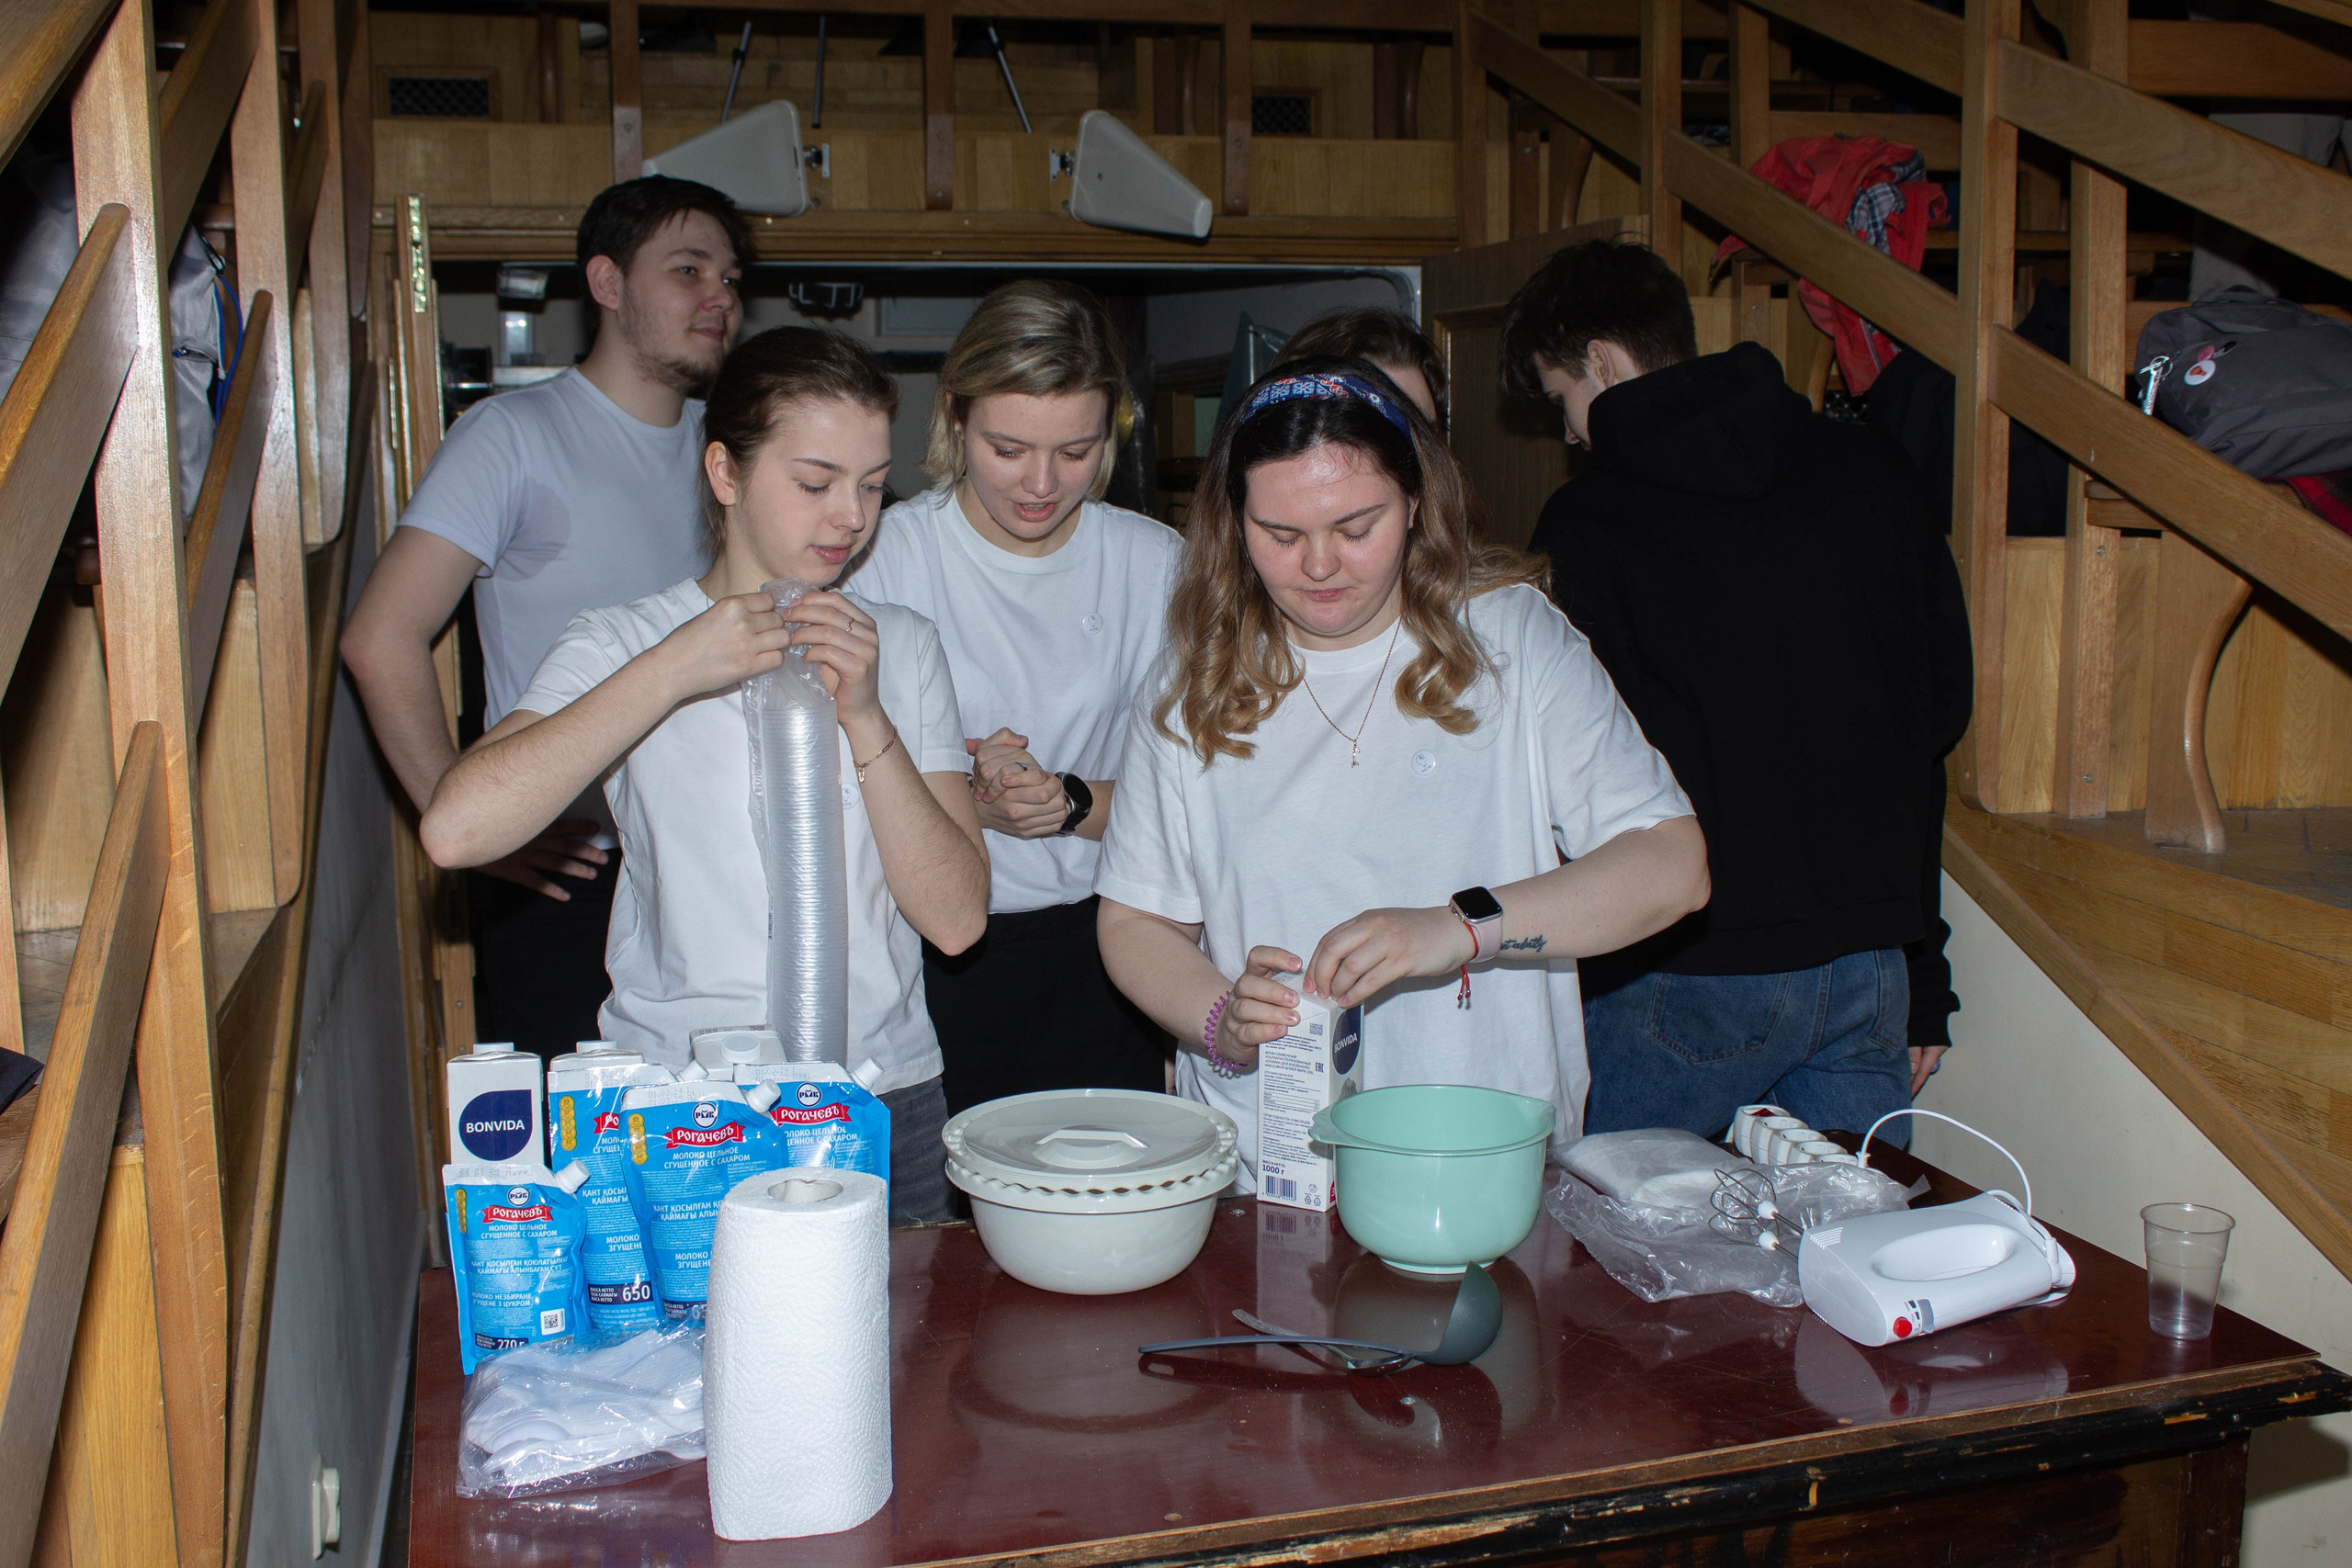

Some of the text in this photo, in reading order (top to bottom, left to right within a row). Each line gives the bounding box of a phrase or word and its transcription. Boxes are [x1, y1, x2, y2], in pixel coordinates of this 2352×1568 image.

[1334, 1032, 1358, 1053] BONVIDA
[466, 1120, 525, 1134] BONVIDA
[812, 1126, 847, 1136] ЦЕЛЬНОЕ
[673, 1147, 739, 1160] МОЛОКО ЦЕЛЬНОЕ
[663, 1158, 709, 1169] СГУЩЕННОЕ
[717, 1155, 751, 1165] САХАРОМ
[1262, 1164, 1280, 1175] 1000
[606, 1235, 639, 1244] МОЛОКО
[675, 1251, 708, 1260] МОЛОКО
[622, 1285, 650, 1302] 650
[503, 1300, 531, 1308] ЦУКРОМ
[498, 1339, 517, 1350] 270
